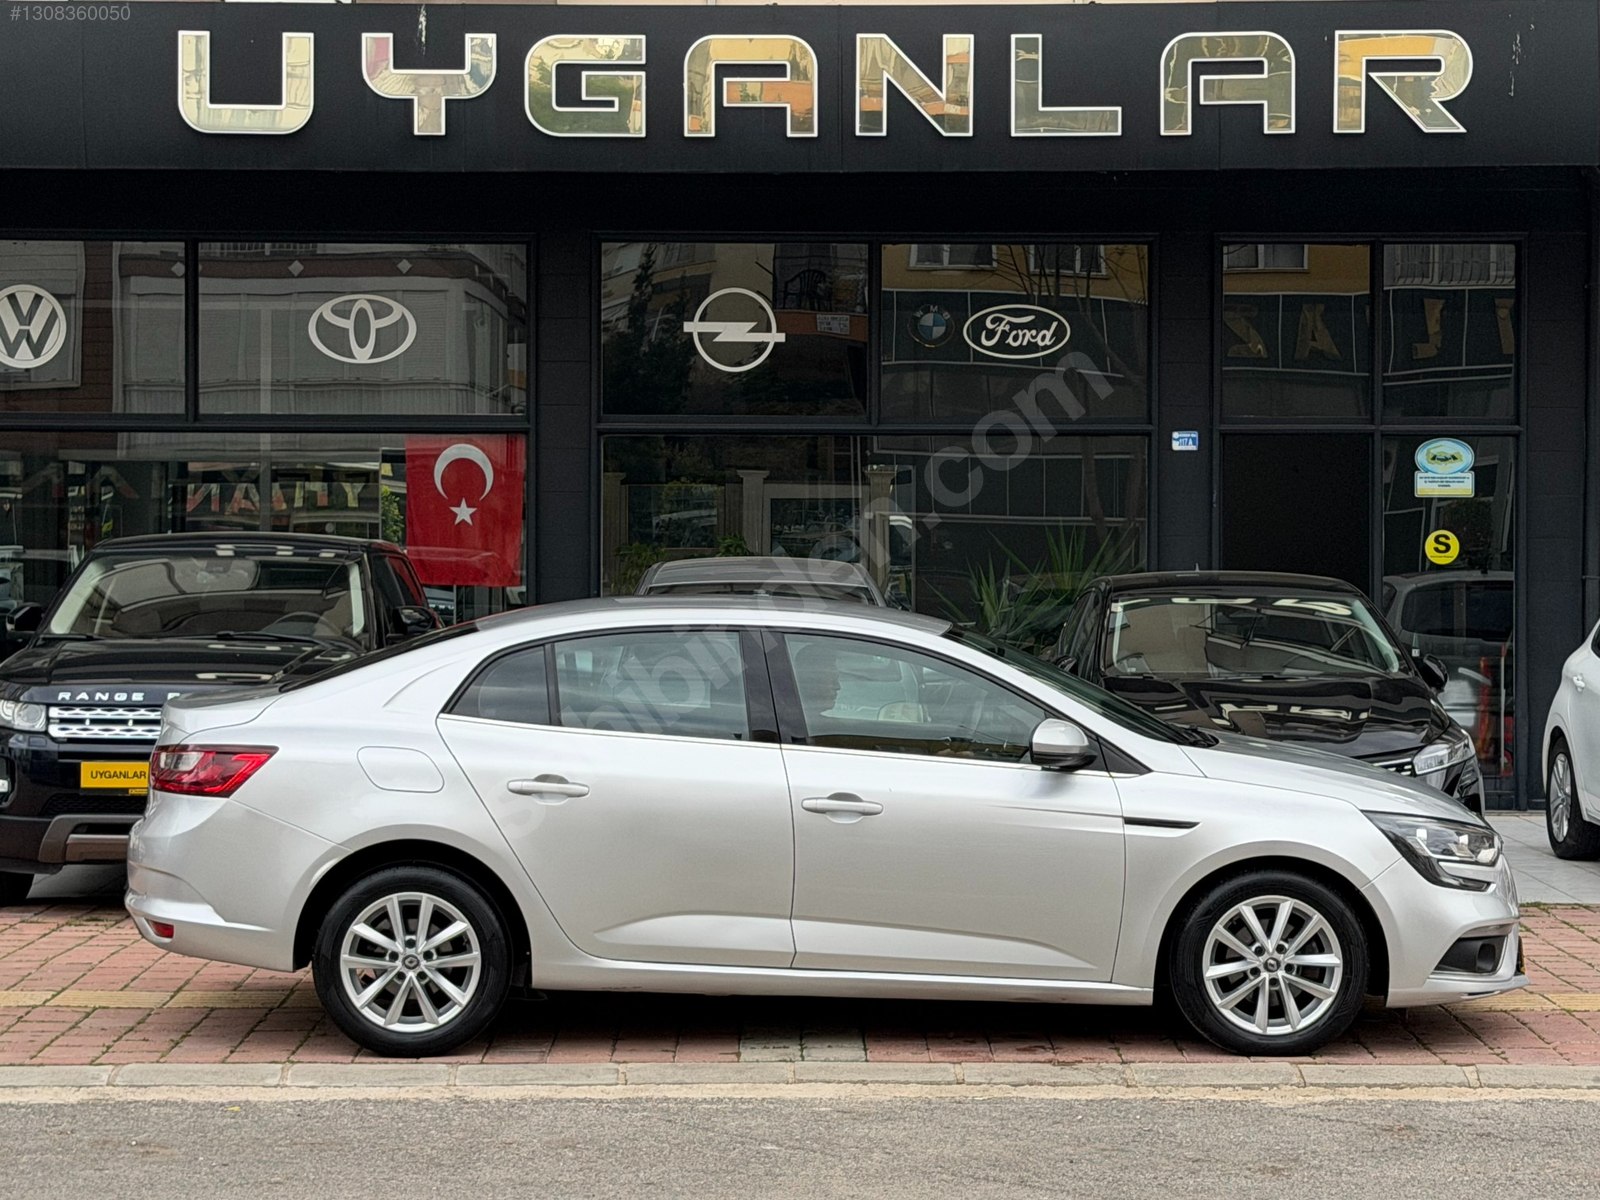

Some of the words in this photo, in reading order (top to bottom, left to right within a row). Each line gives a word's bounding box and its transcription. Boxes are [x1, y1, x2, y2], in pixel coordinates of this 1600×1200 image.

[177, 30, 1474, 138] UYGANLAR
[980, 313, 1059, 348] Ford
[1433, 533, 1452, 554] S
[58, 691, 145, 701] RANGE
[90, 770, 147, 780] UYGANLAR
